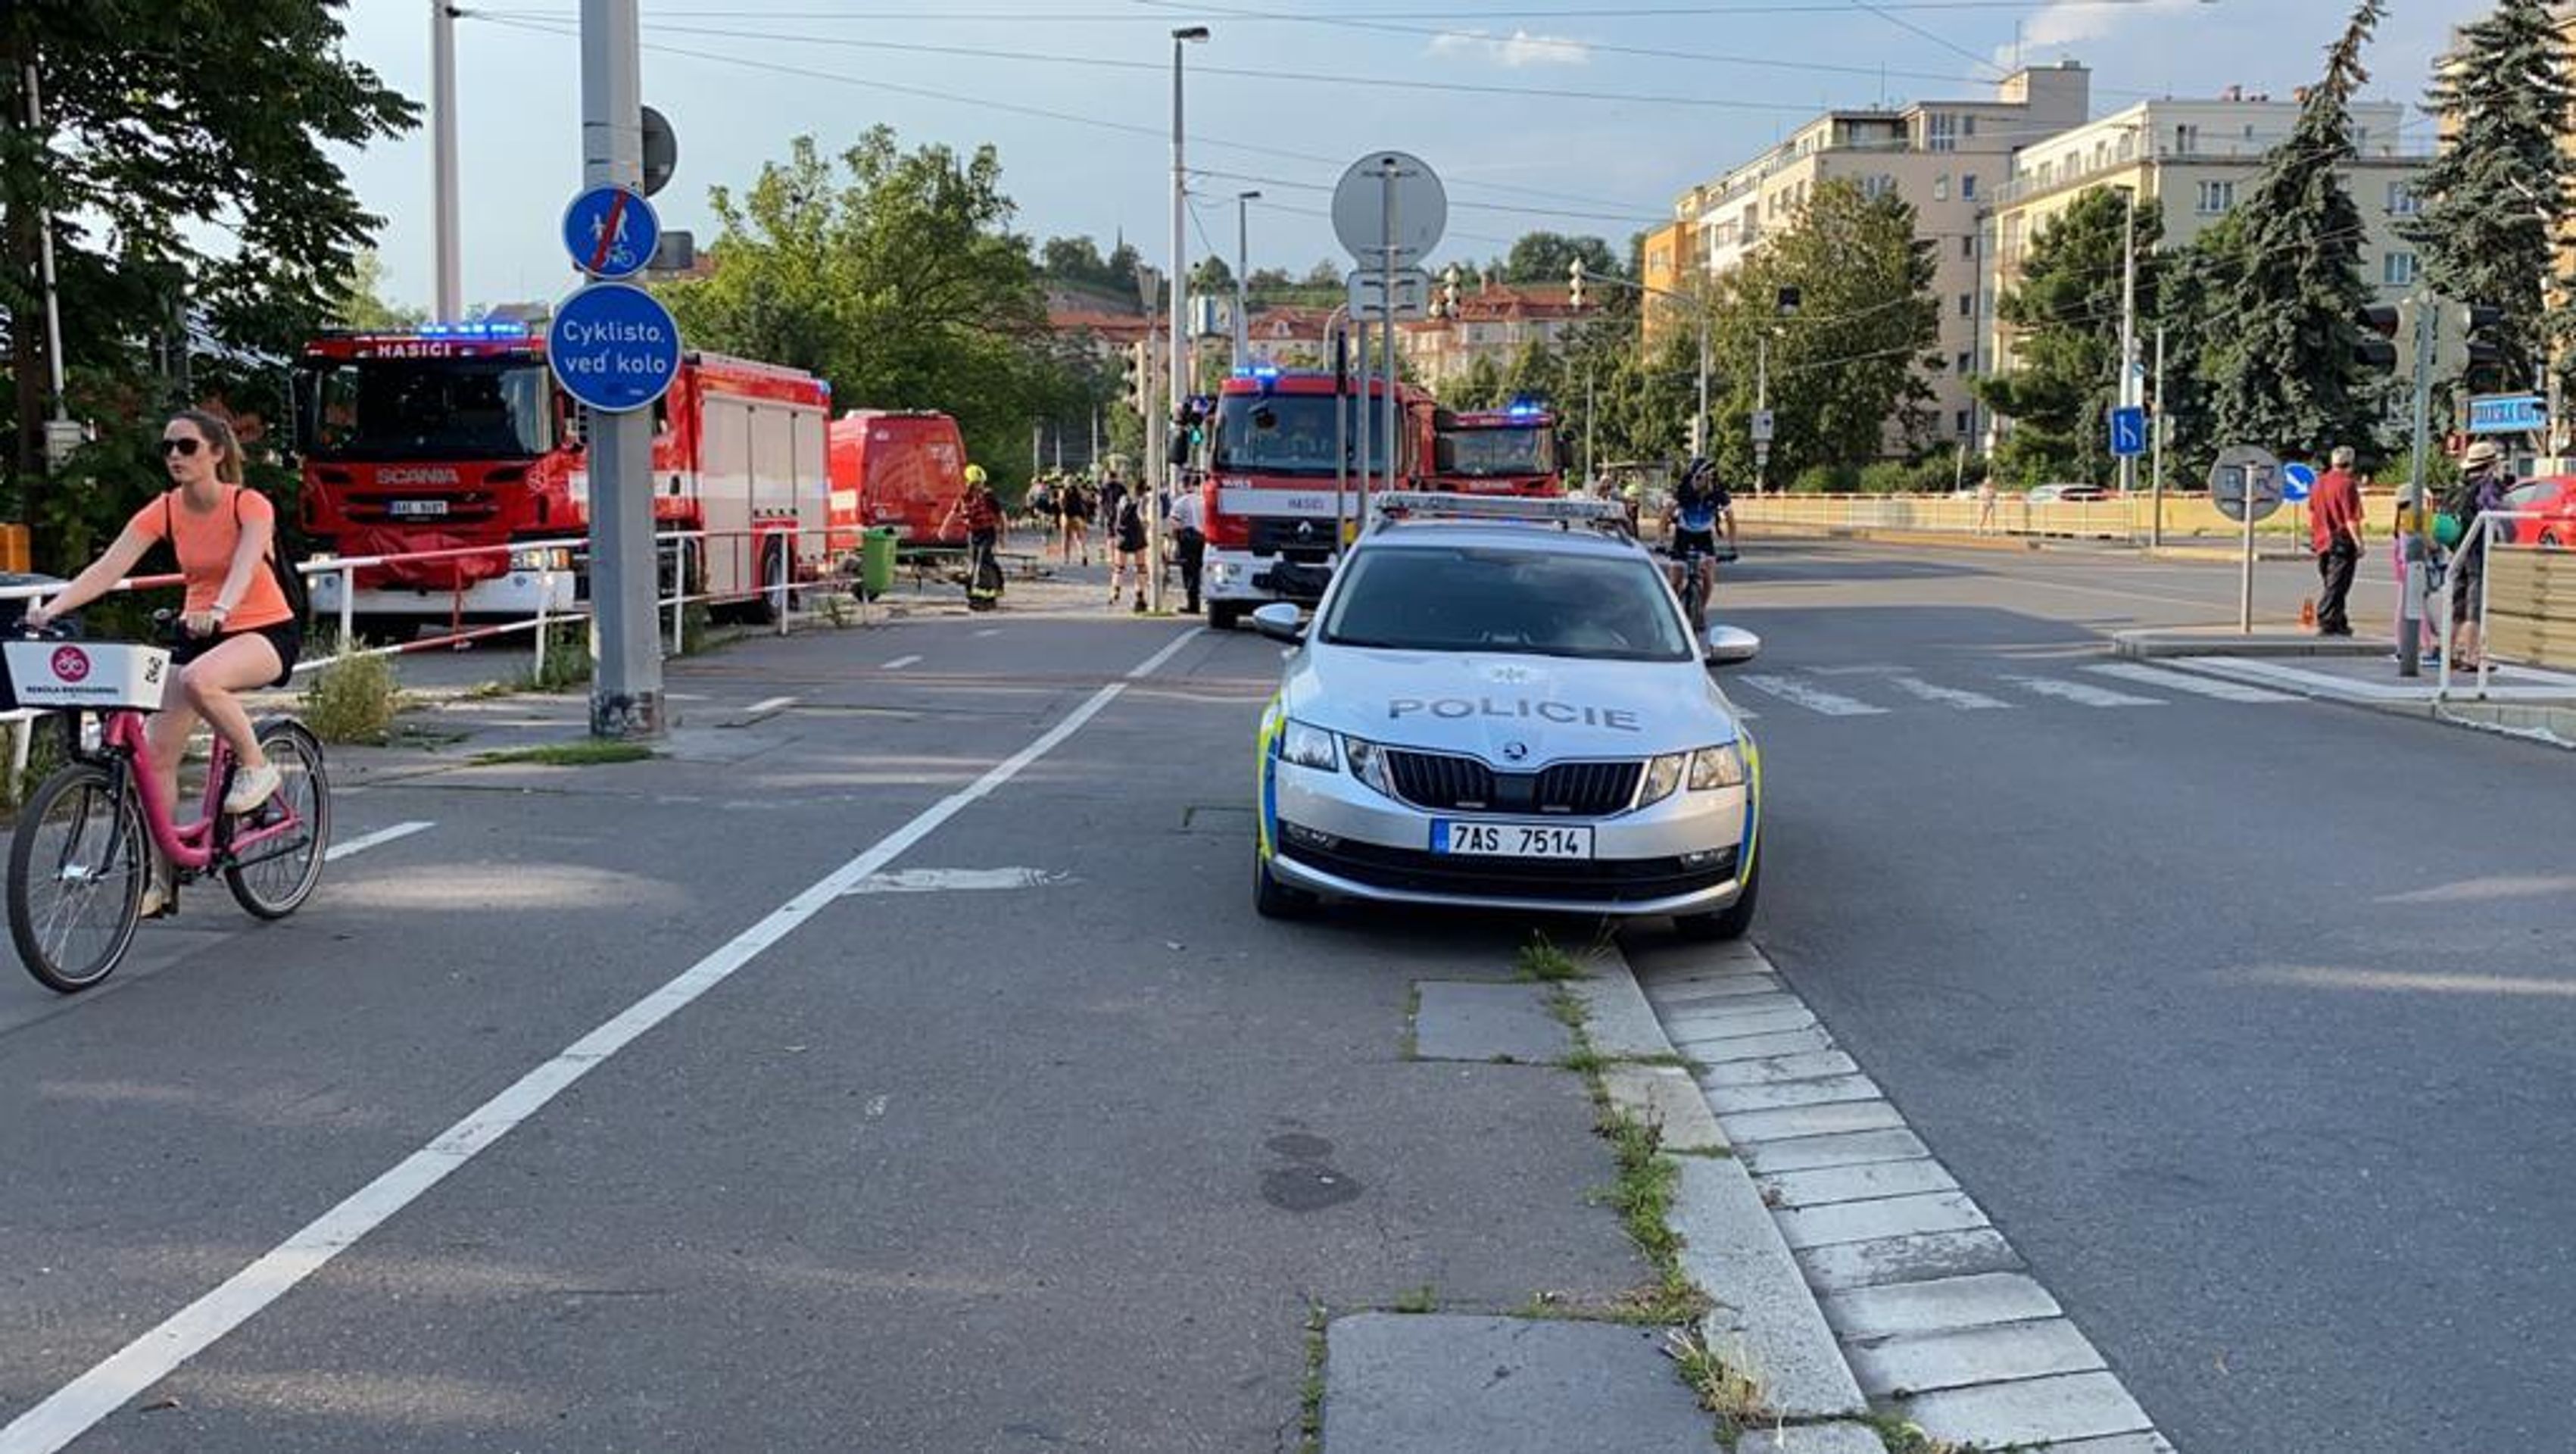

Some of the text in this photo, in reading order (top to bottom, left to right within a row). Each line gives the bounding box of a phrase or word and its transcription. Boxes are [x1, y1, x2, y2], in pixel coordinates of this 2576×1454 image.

[617, 351, 667, 373] kolo
[376, 469, 460, 484] SCANIA
[1388, 698, 1641, 732] POLICIE
[1454, 826, 1579, 854] 7AS 7514
